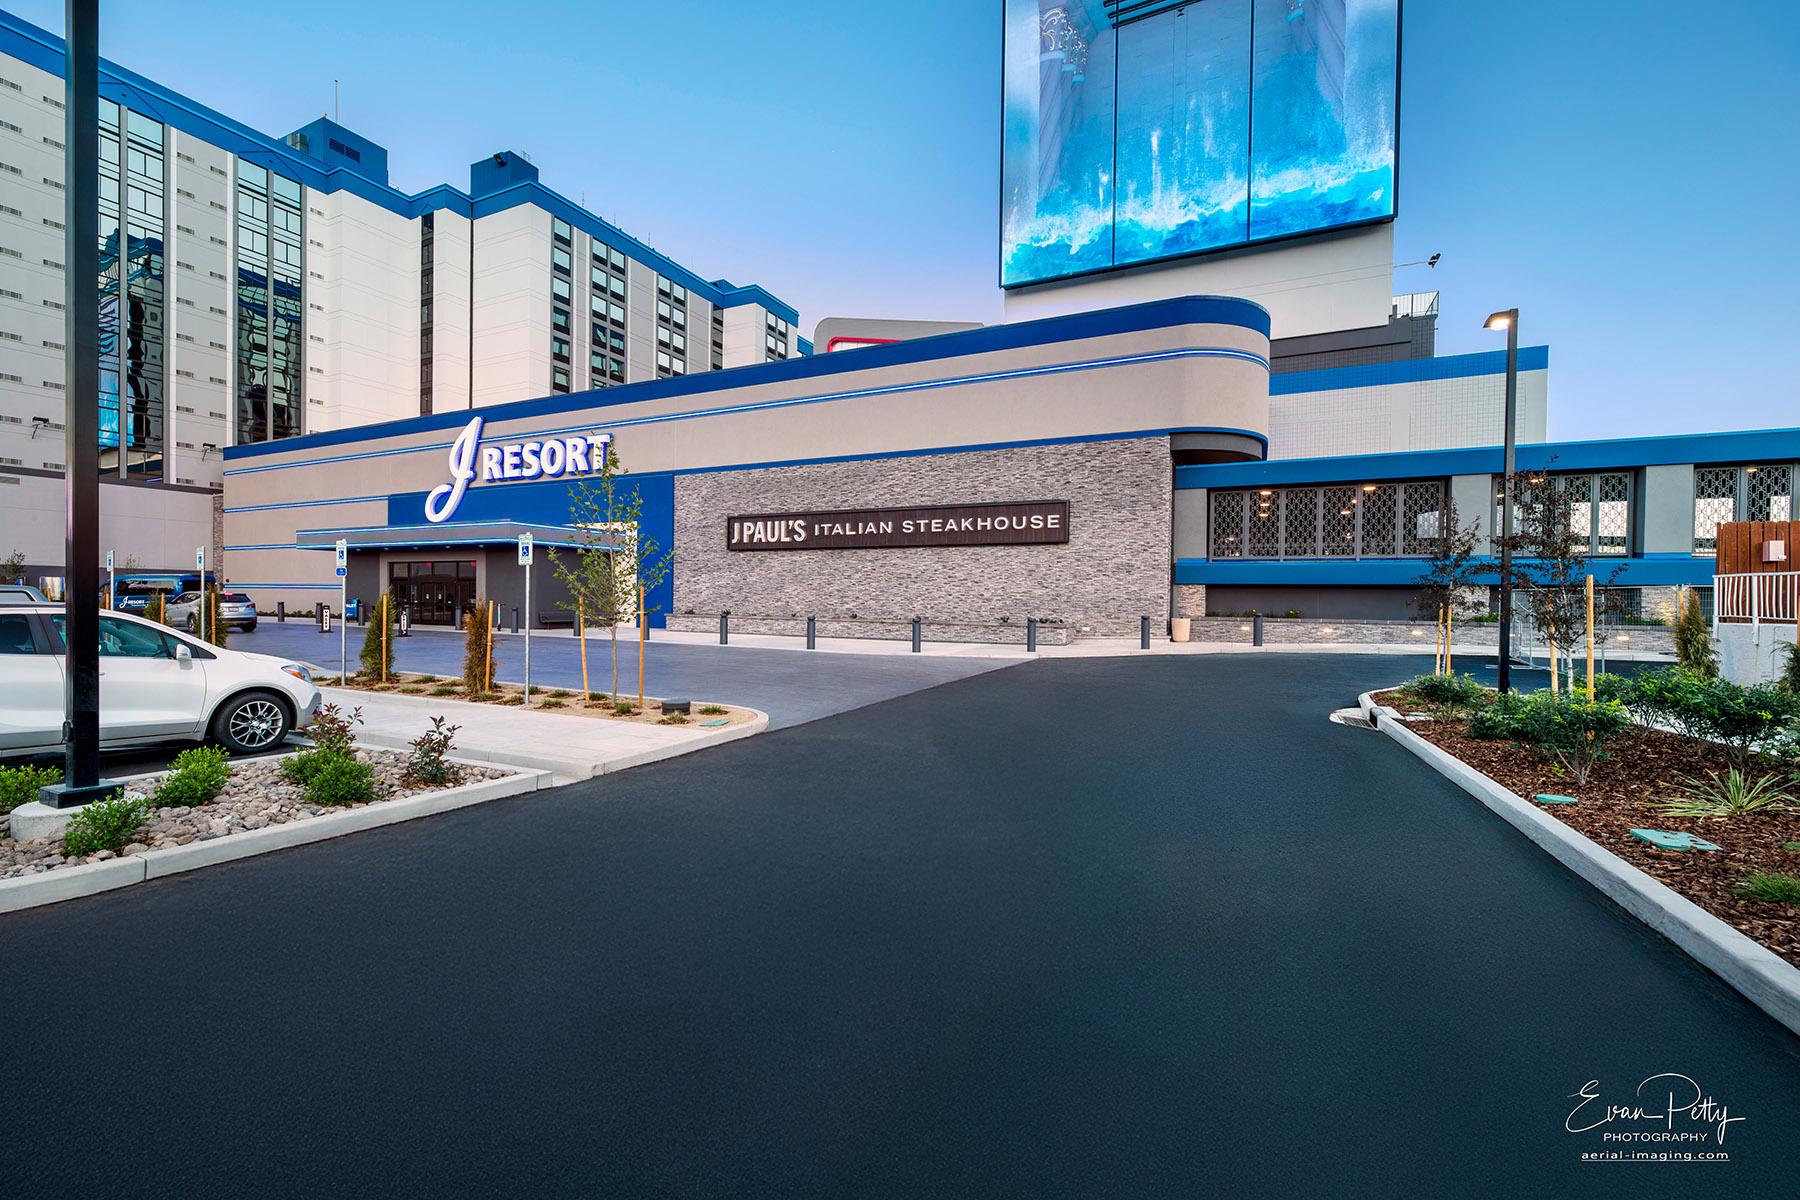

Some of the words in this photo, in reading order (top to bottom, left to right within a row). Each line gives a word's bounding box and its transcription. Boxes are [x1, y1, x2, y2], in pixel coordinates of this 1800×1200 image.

[425, 416, 484, 523] J
[482, 433, 614, 482] RESORT
[743, 519, 807, 543] PAUL'S
[814, 521, 893, 536] ITALIAN
[902, 514, 1061, 533] STEAKHOUSE
